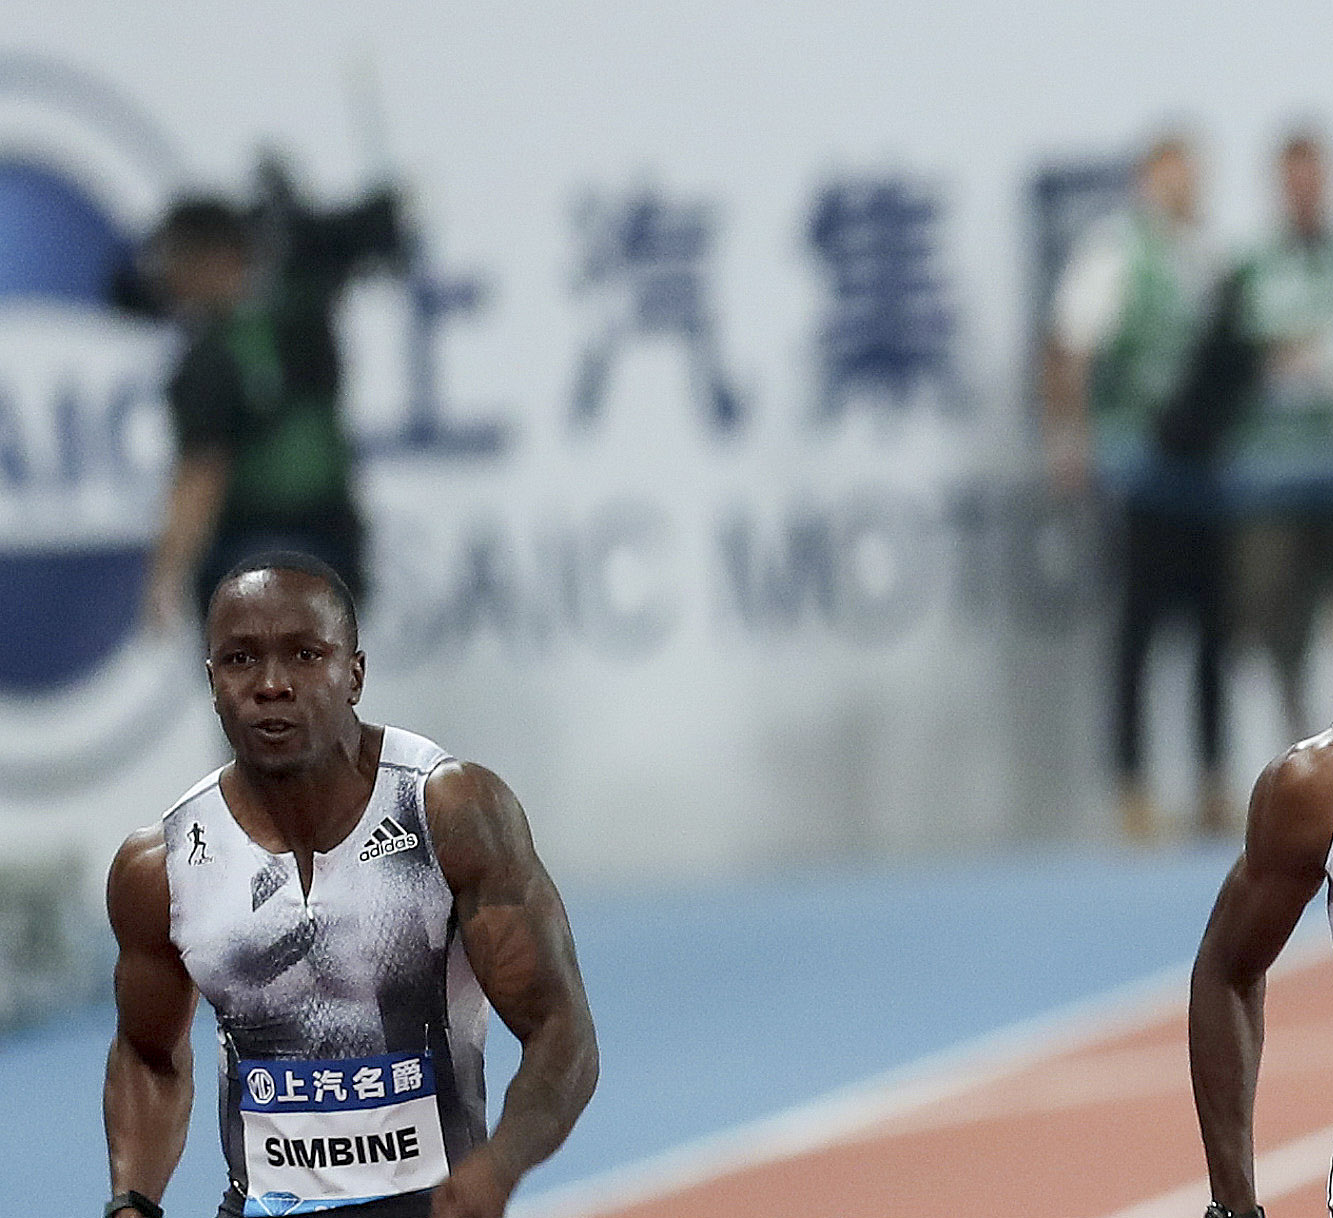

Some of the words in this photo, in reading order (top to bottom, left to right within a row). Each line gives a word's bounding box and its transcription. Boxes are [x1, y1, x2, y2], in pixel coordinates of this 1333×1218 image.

[359, 834, 418, 862] adidas
[277, 1058, 423, 1103] 上汽名爵
[265, 1126, 420, 1168] SIMBINE
